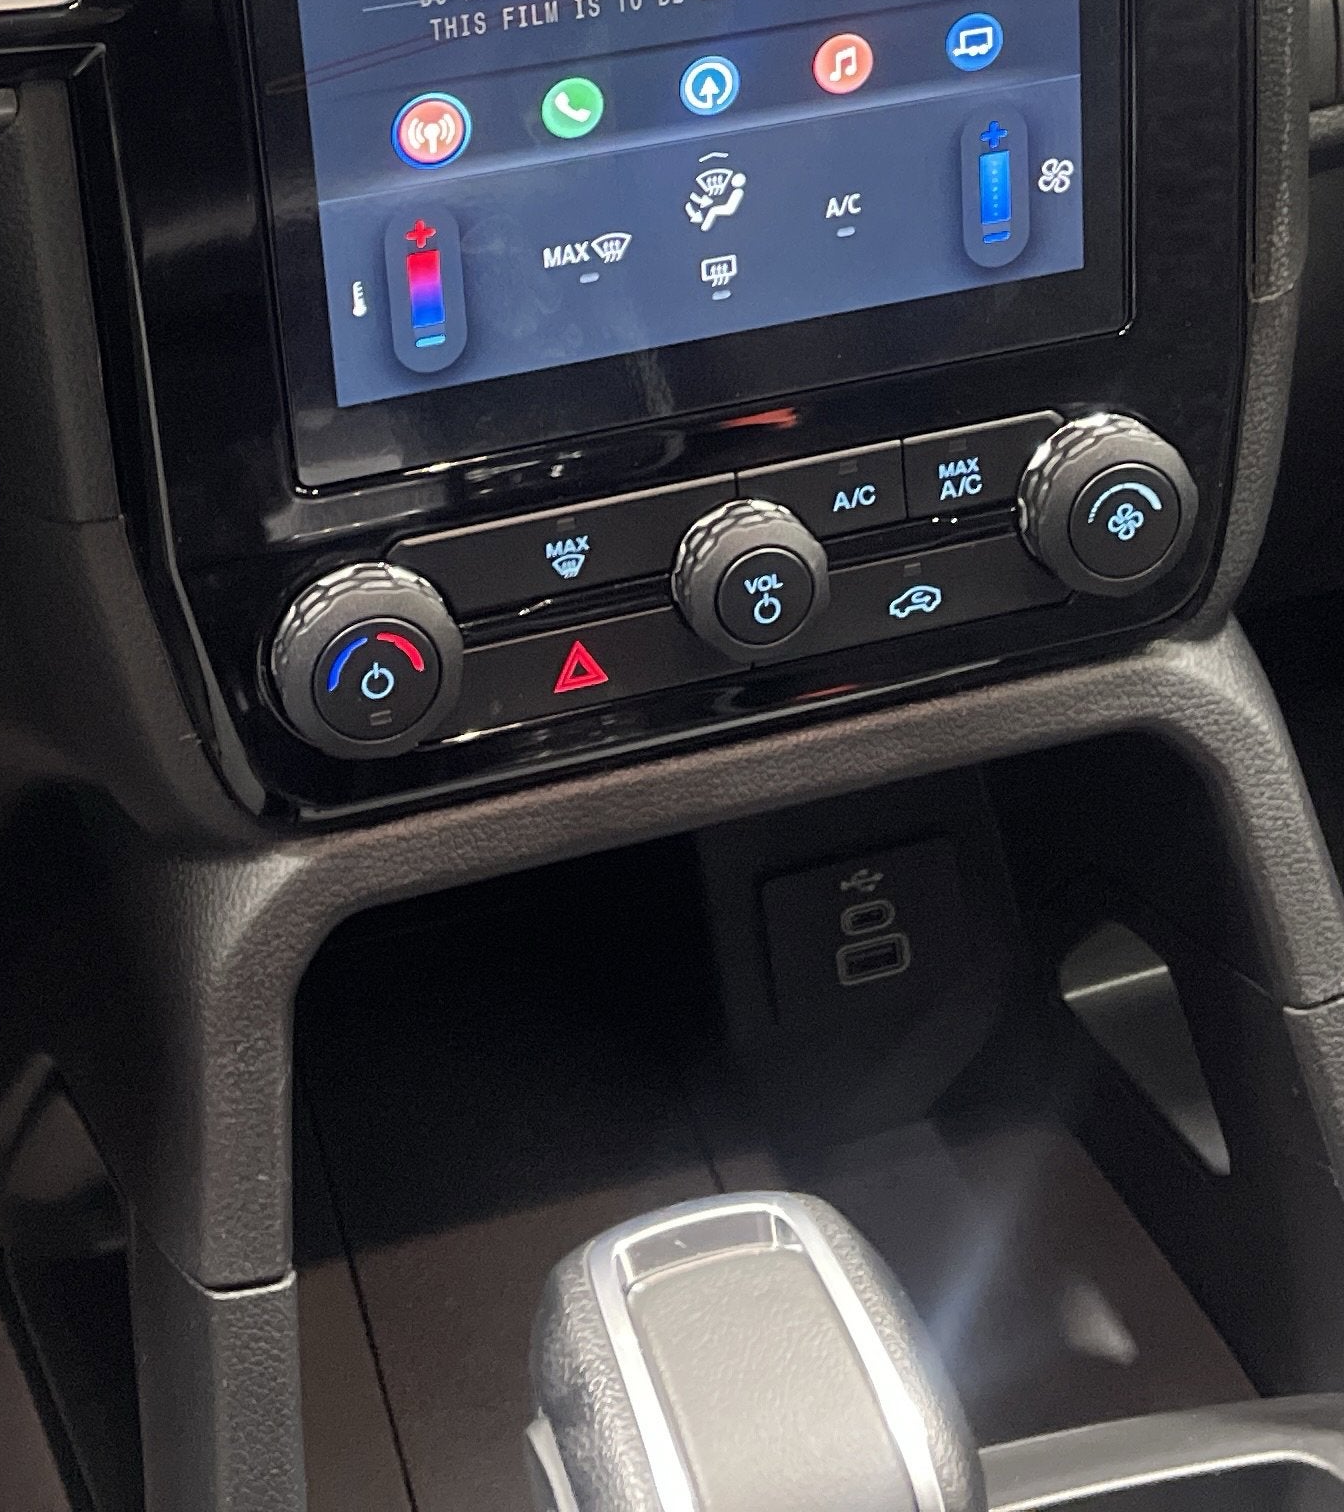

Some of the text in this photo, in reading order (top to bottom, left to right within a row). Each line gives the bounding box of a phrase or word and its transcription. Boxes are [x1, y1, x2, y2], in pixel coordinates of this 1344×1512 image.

[429, 11, 487, 41] THIS
[502, 0, 559, 31] FILM
[825, 193, 862, 219] A/C
[543, 240, 591, 269] MAX
[938, 456, 980, 479] MAX
[832, 484, 877, 513] A/C
[940, 478, 984, 501] A/C
[545, 535, 590, 559] MAX
[743, 573, 784, 595] VOL
